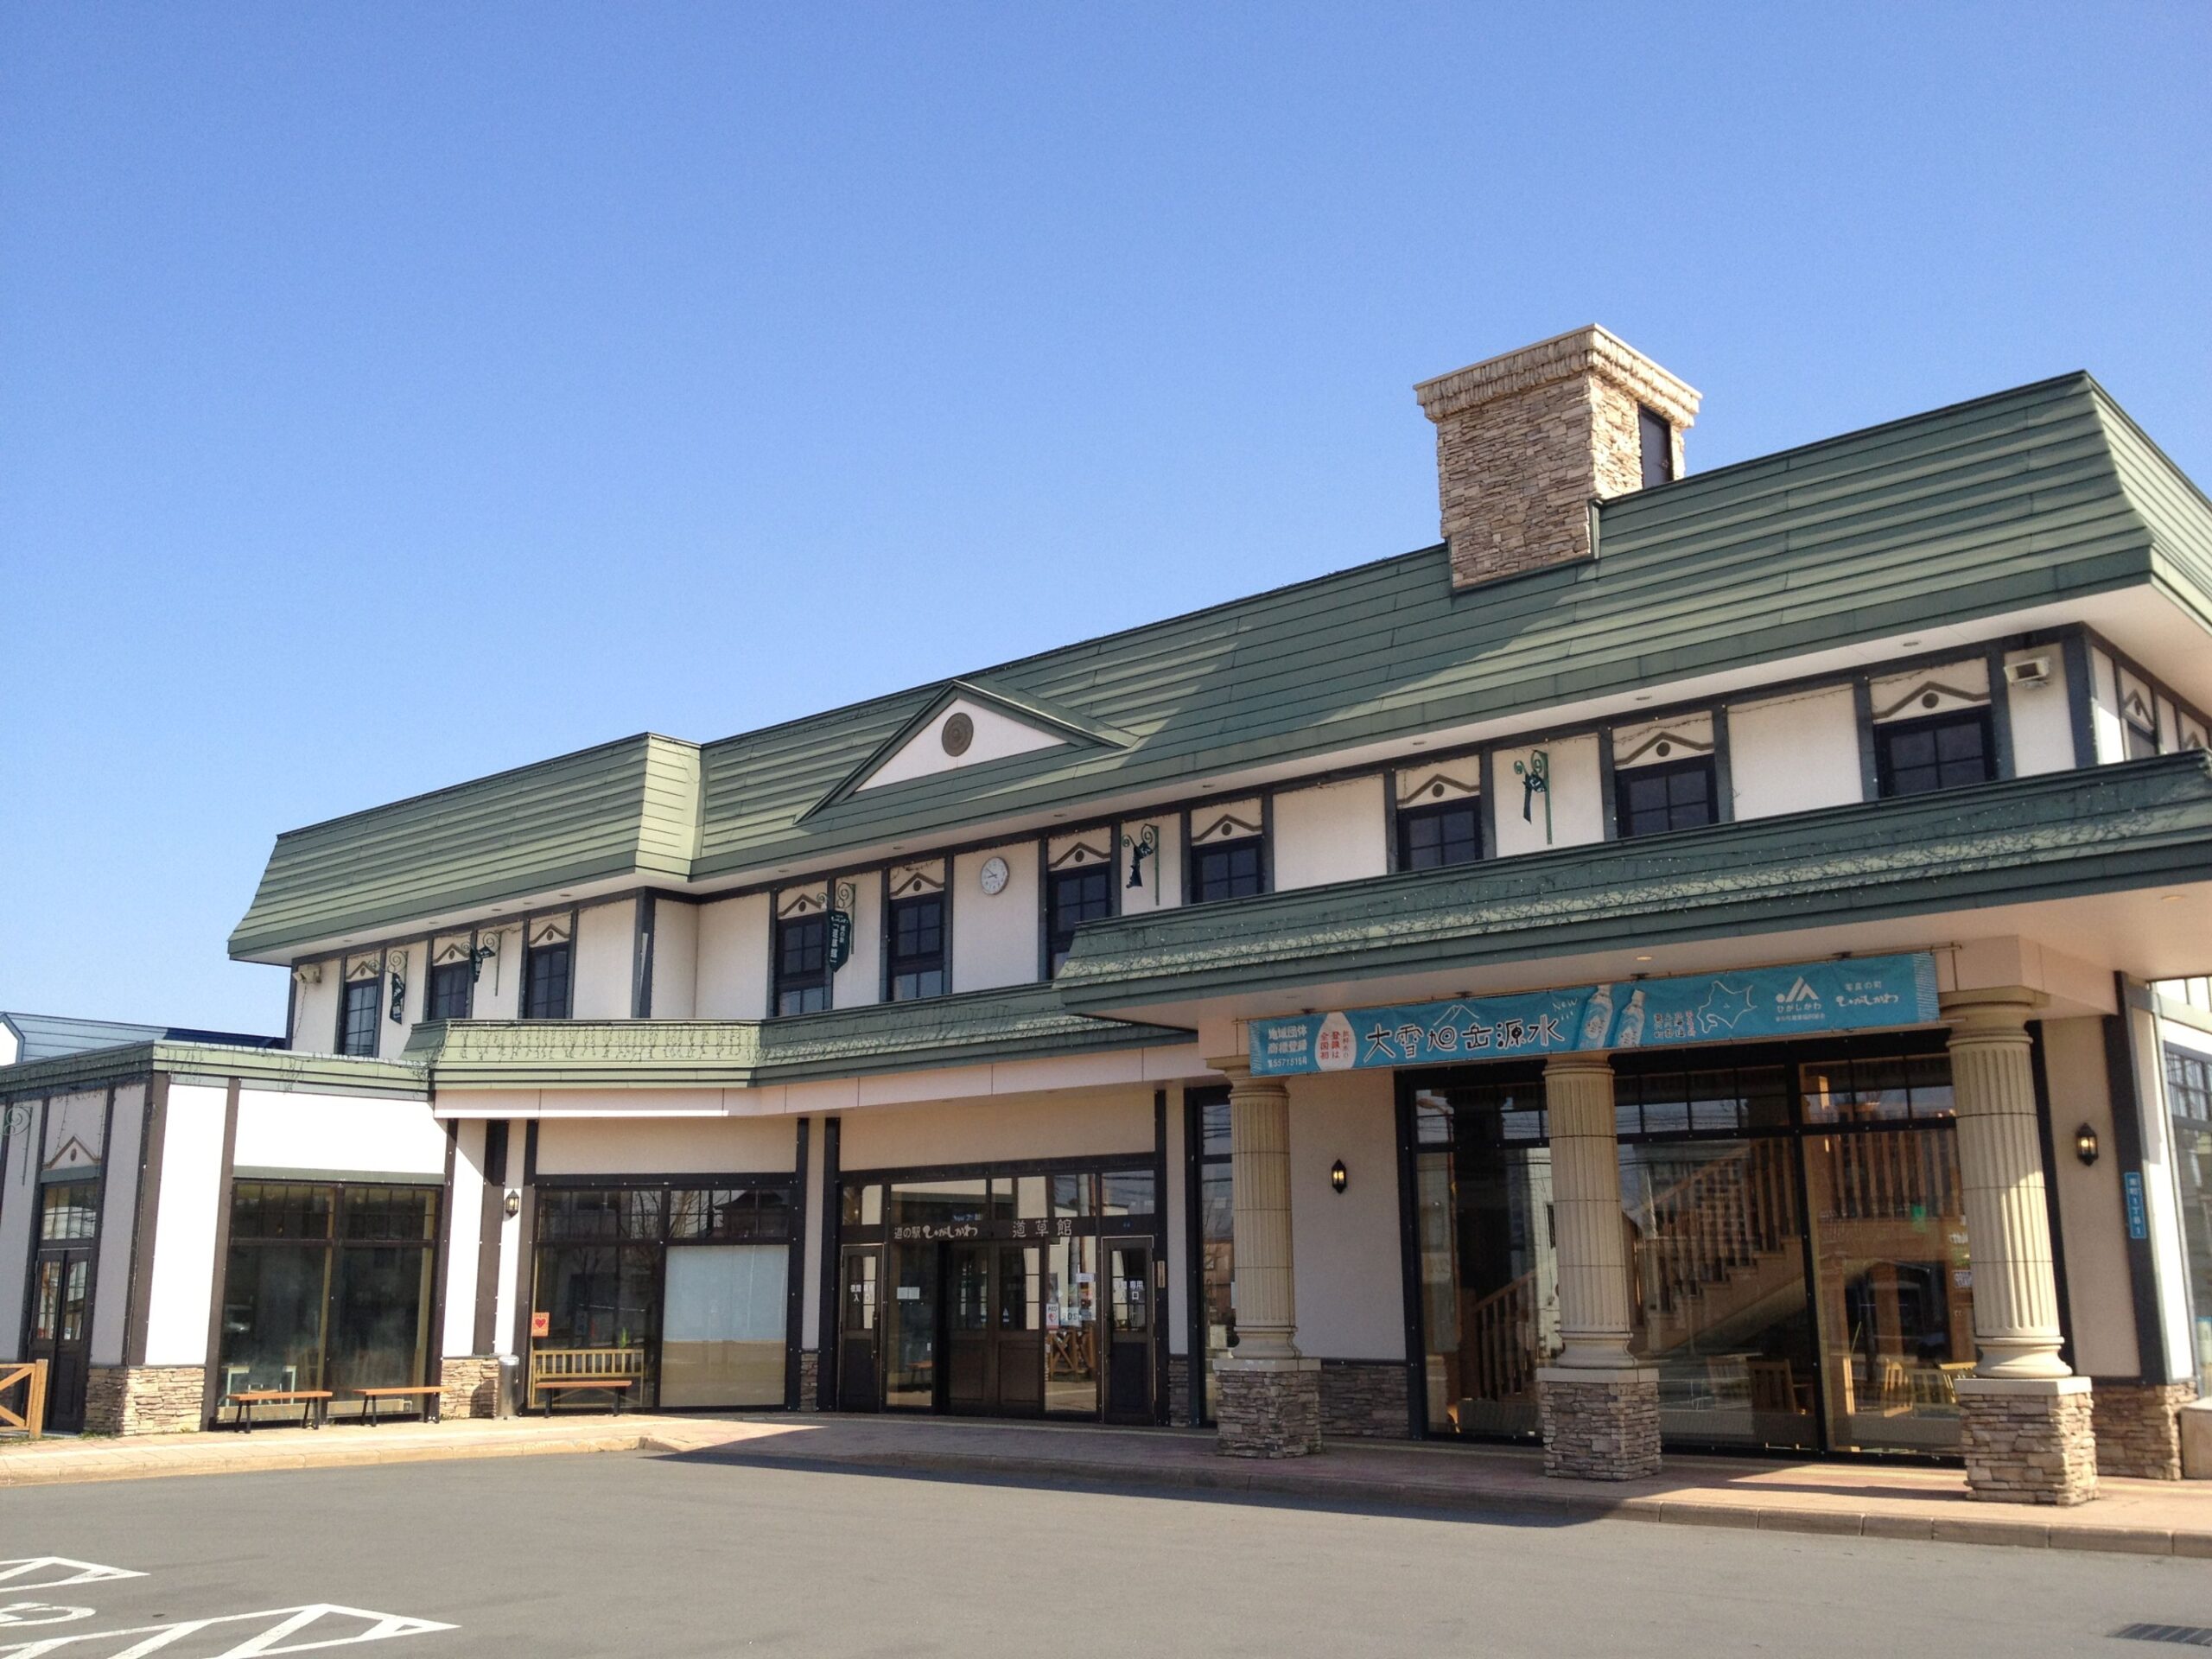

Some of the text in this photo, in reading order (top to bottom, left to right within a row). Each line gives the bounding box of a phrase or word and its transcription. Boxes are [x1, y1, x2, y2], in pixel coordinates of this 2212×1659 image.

[1777, 1003, 1822, 1014] ひがしかわ
[1363, 1014, 1566, 1065] 大雪旭岳源水
[1012, 1218, 1072, 1238] 道草館
